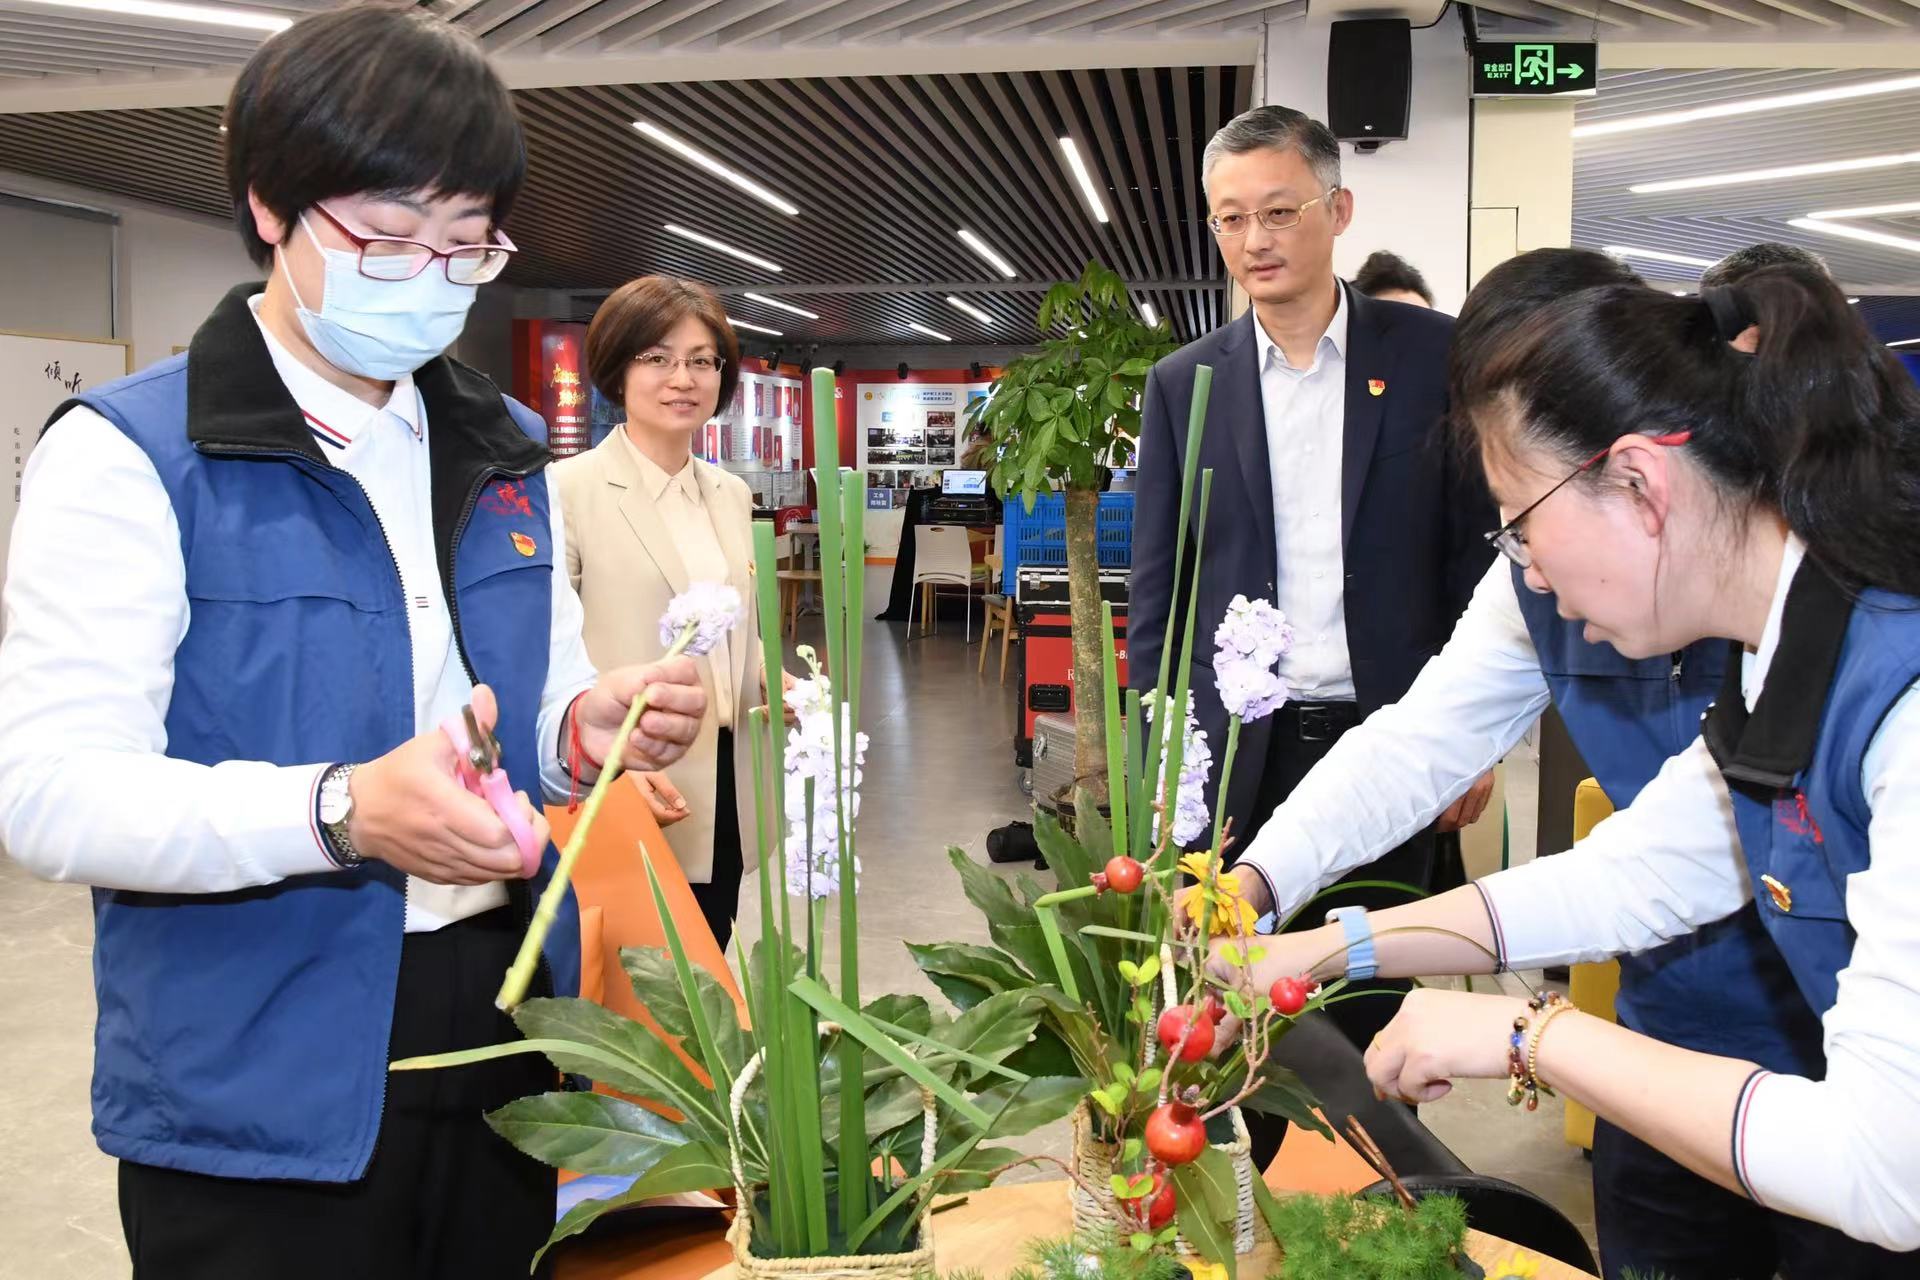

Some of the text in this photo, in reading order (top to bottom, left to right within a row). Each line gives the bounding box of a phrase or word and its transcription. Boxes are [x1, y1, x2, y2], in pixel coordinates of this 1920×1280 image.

[1484, 63, 1512, 72] 安全出口
[44, 361, 82, 394] 倾听
